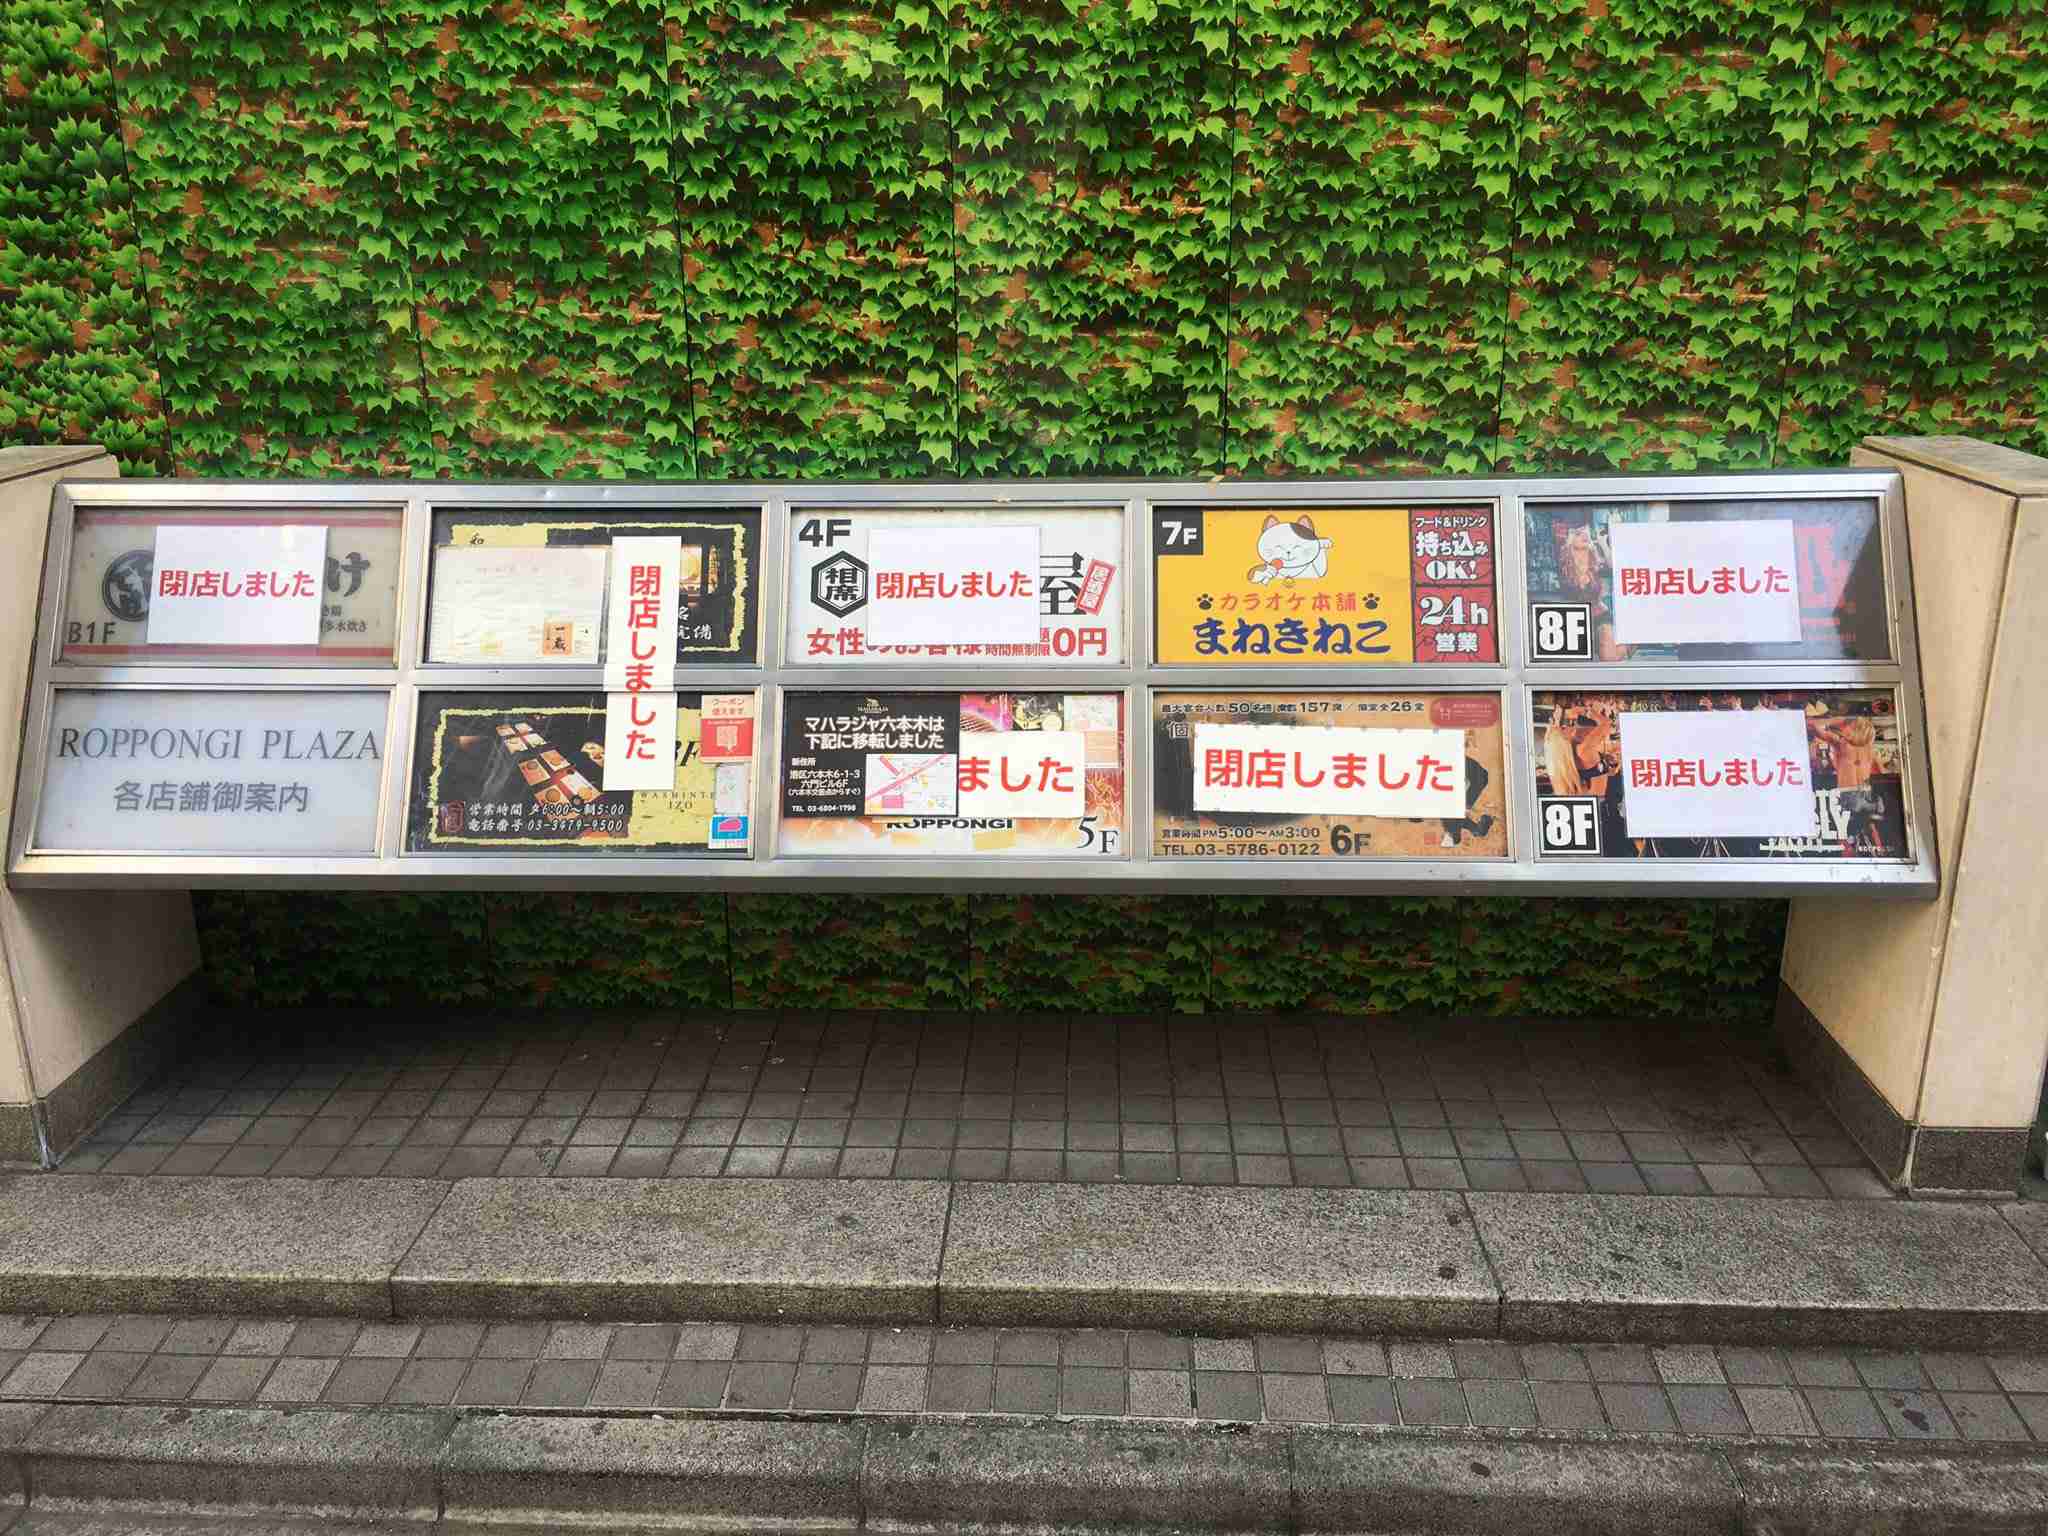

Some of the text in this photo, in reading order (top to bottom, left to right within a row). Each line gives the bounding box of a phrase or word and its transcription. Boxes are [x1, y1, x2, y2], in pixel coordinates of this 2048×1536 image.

[798, 519, 852, 548] 4F
[1161, 520, 1197, 546] 7F
[1415, 530, 1489, 558] 持ち込み
[158, 569, 316, 599] 閉店しました
[824, 567, 859, 603] 相席
[1424, 558, 1479, 581] OK!
[1620, 565, 1790, 596] 閉店しました
[874, 571, 1034, 600] 閉店しました
[1219, 591, 1357, 613] カラオケ本舗
[66, 621, 117, 645] B1F
[1052, 627, 1108, 657] 0円
[1192, 617, 1392, 656] まねきねこ
[1434, 631, 1480, 654] 営業
[1537, 609, 1585, 652] 8F
[624, 565, 662, 762] 閉店しました
[804, 715, 945, 733] マハラジャ六本木は
[58, 726, 381, 762] ROPPONGI PLAZA
[804, 733, 945, 750] 下記に移転しました
[958, 755, 1074, 793] ました
[1204, 748, 1454, 793] 閉店しました
[1630, 758, 1804, 789] 閉店しました
[113, 780, 310, 814] 各店舗御案内
[1076, 815, 1119, 855] 5F
[1330, 824, 1372, 856] 6F
[1543, 804, 1593, 848] 8F
